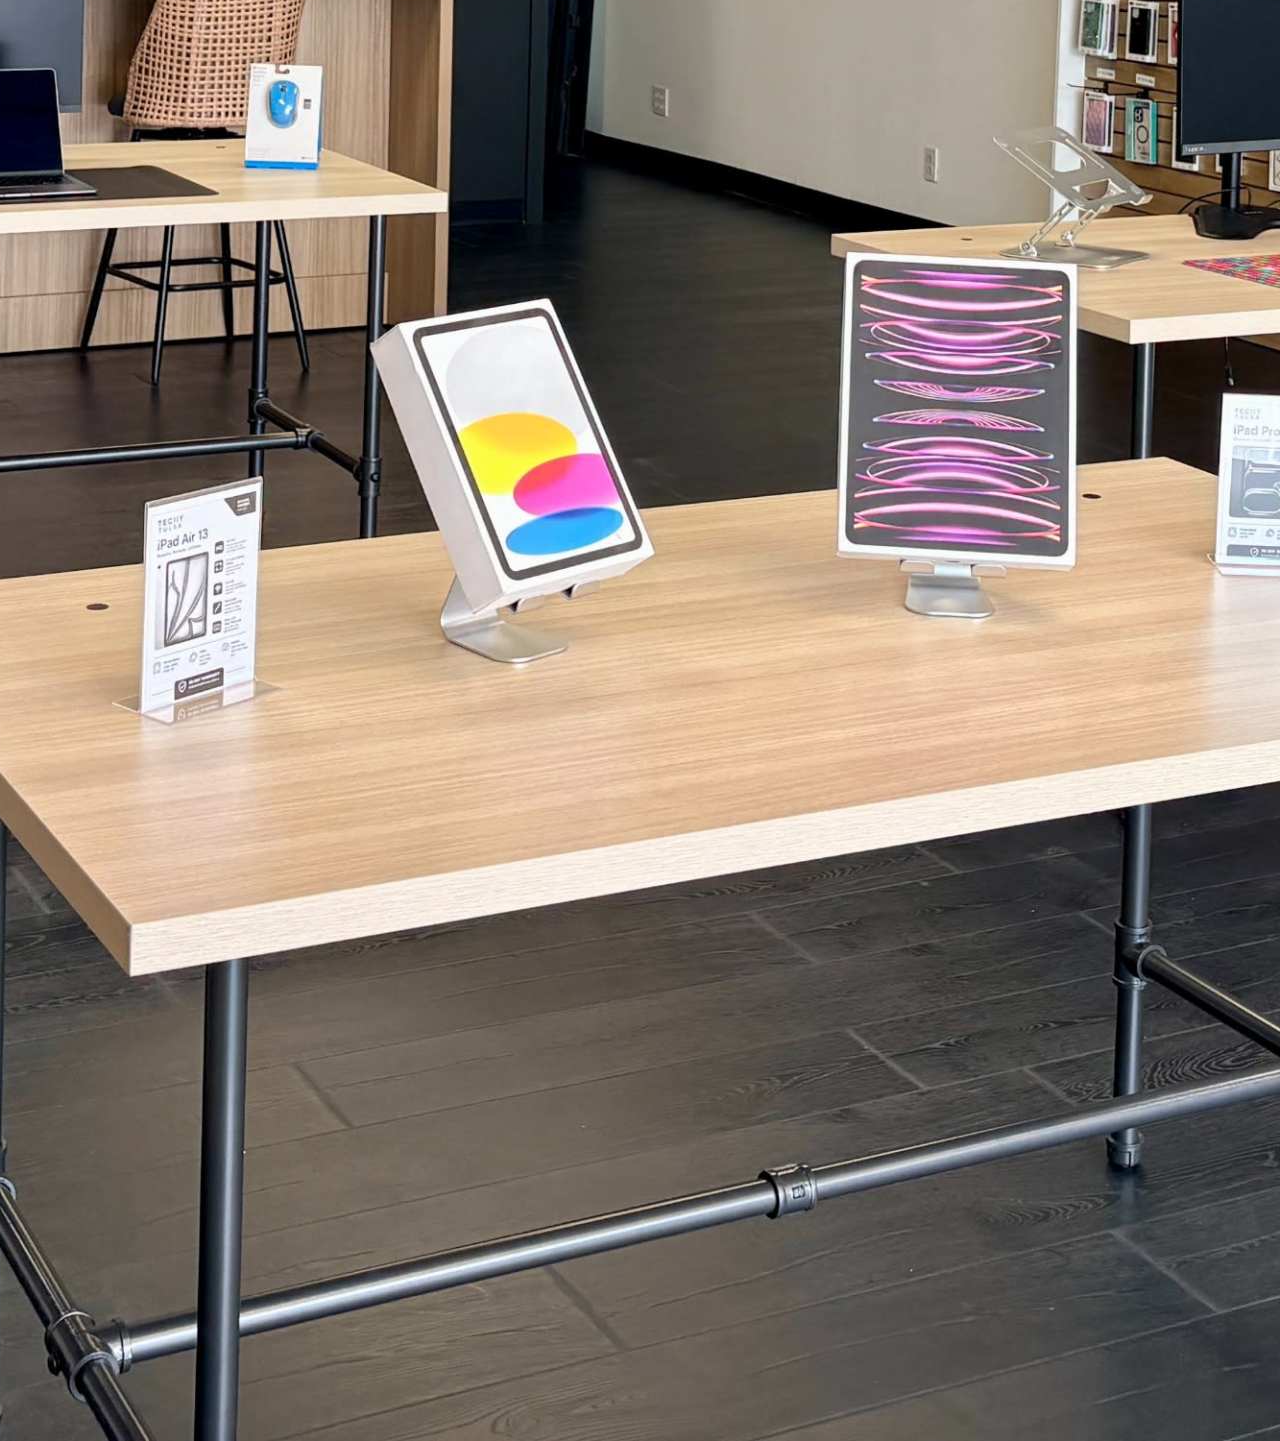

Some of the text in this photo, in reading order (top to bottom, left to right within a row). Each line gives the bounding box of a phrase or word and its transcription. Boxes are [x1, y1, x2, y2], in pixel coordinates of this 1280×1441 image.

[1233, 425, 1280, 437] iPad Pro
[157, 528, 209, 551] iPad Air 13
